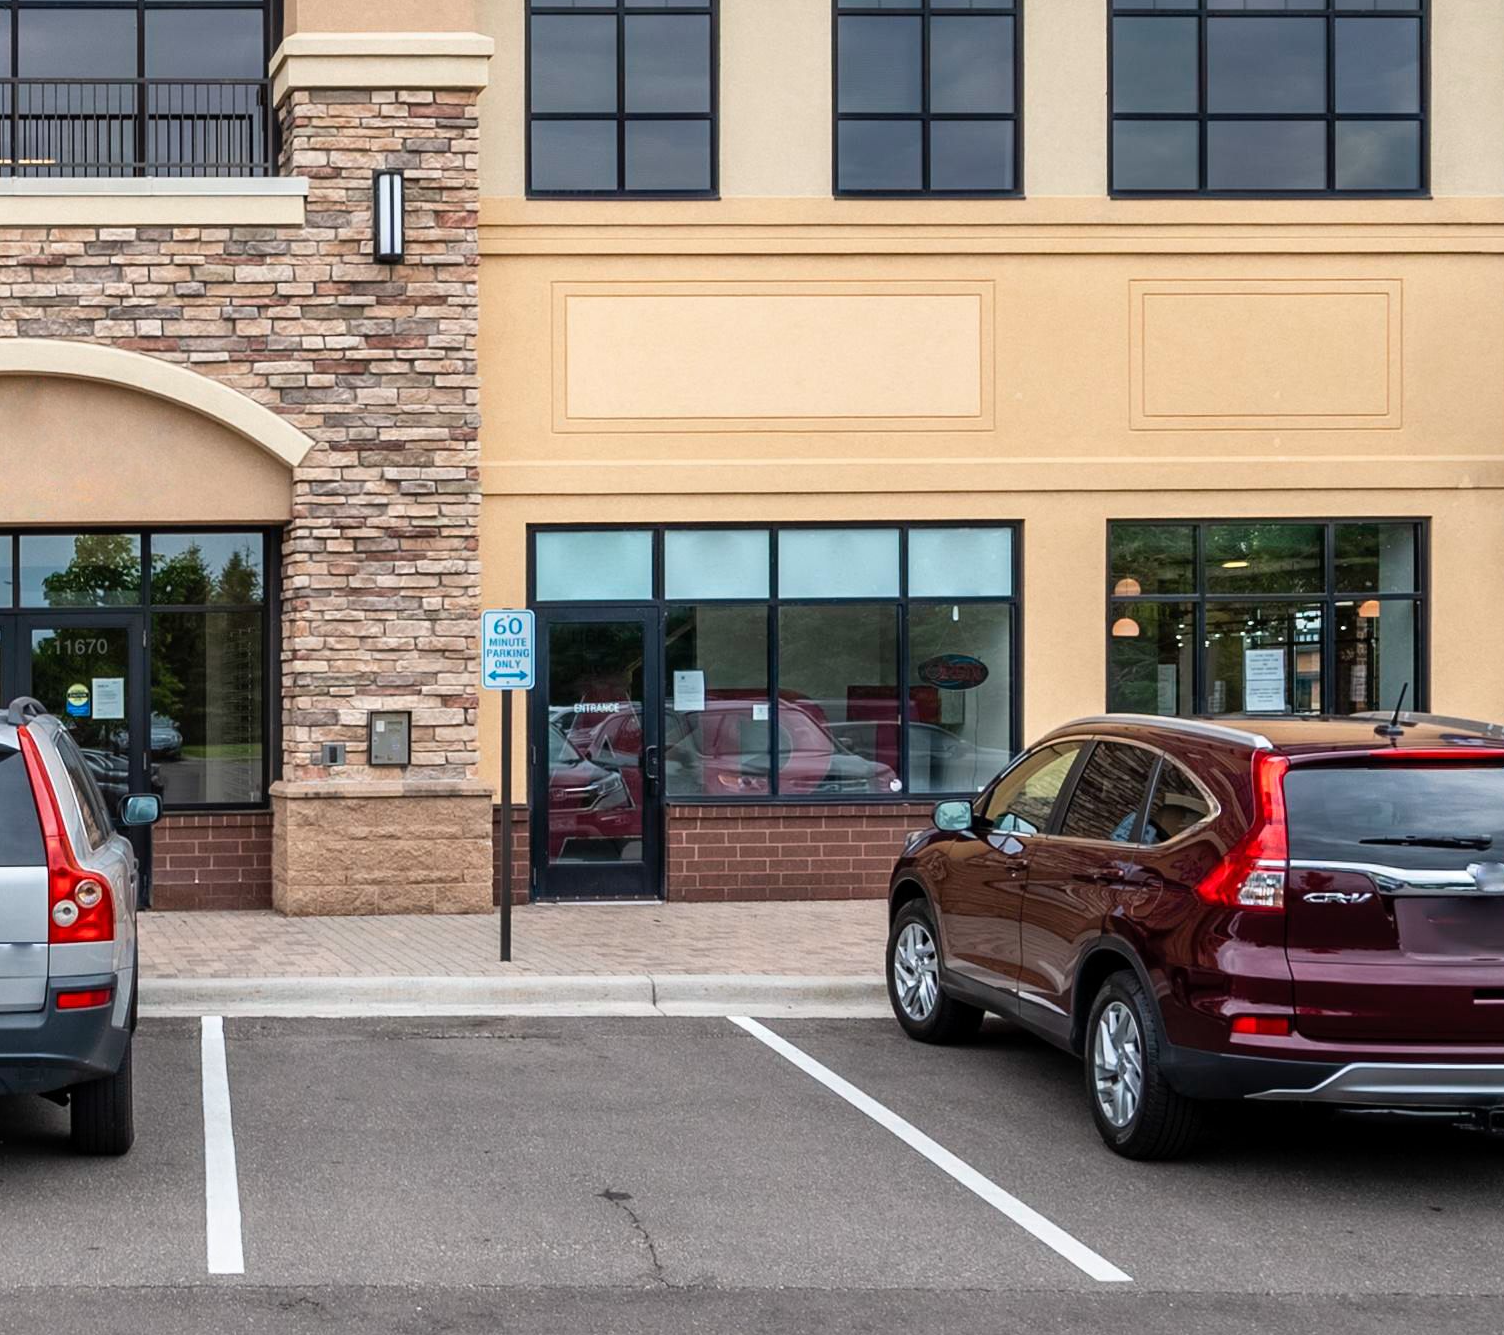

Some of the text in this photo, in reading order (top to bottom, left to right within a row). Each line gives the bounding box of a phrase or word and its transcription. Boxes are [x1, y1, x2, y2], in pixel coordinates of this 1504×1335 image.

[493, 617, 522, 635] 60
[53, 639, 108, 655] 11670
[489, 638, 527, 647] MINUTE
[486, 649, 530, 658] PARKING
[494, 659, 521, 669] ONLY
[573, 703, 620, 713] ENTRANCE
[1303, 892, 1373, 904] CR-V
